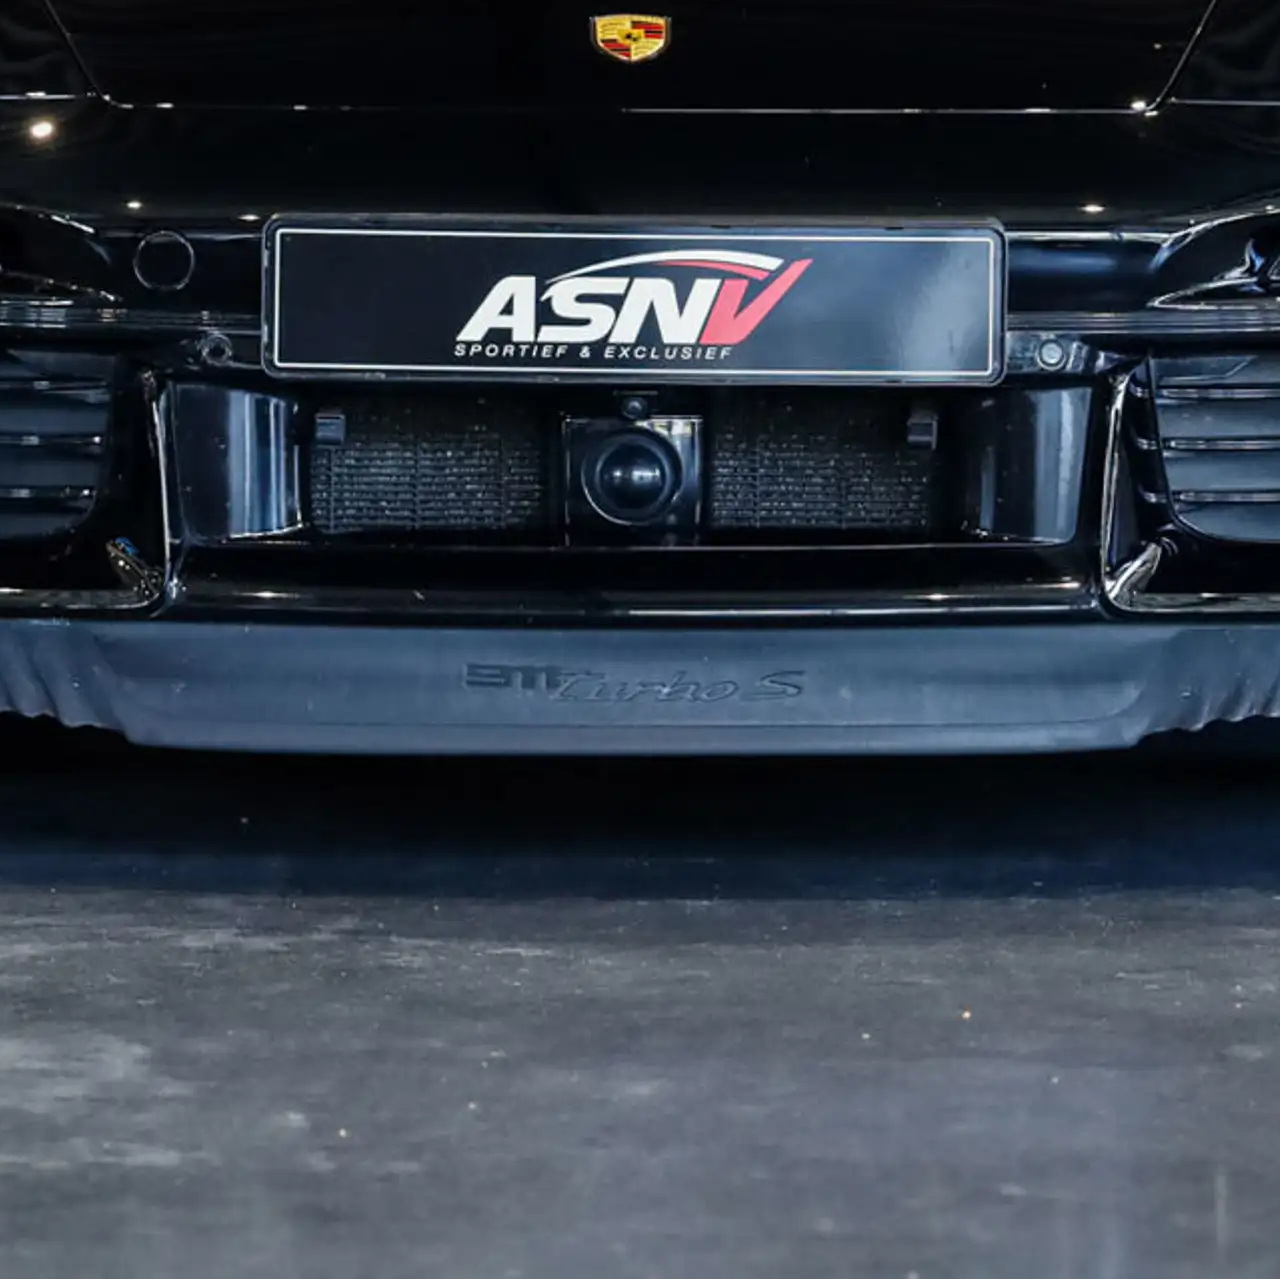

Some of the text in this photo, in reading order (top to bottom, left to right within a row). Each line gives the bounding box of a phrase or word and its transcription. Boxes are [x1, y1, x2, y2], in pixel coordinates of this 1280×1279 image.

[455, 257, 814, 345] ASNV
[454, 343, 733, 360] SPORTIEF & EXCLUSIEF
[551, 669, 740, 703] Turbo
[748, 670, 807, 702] S
